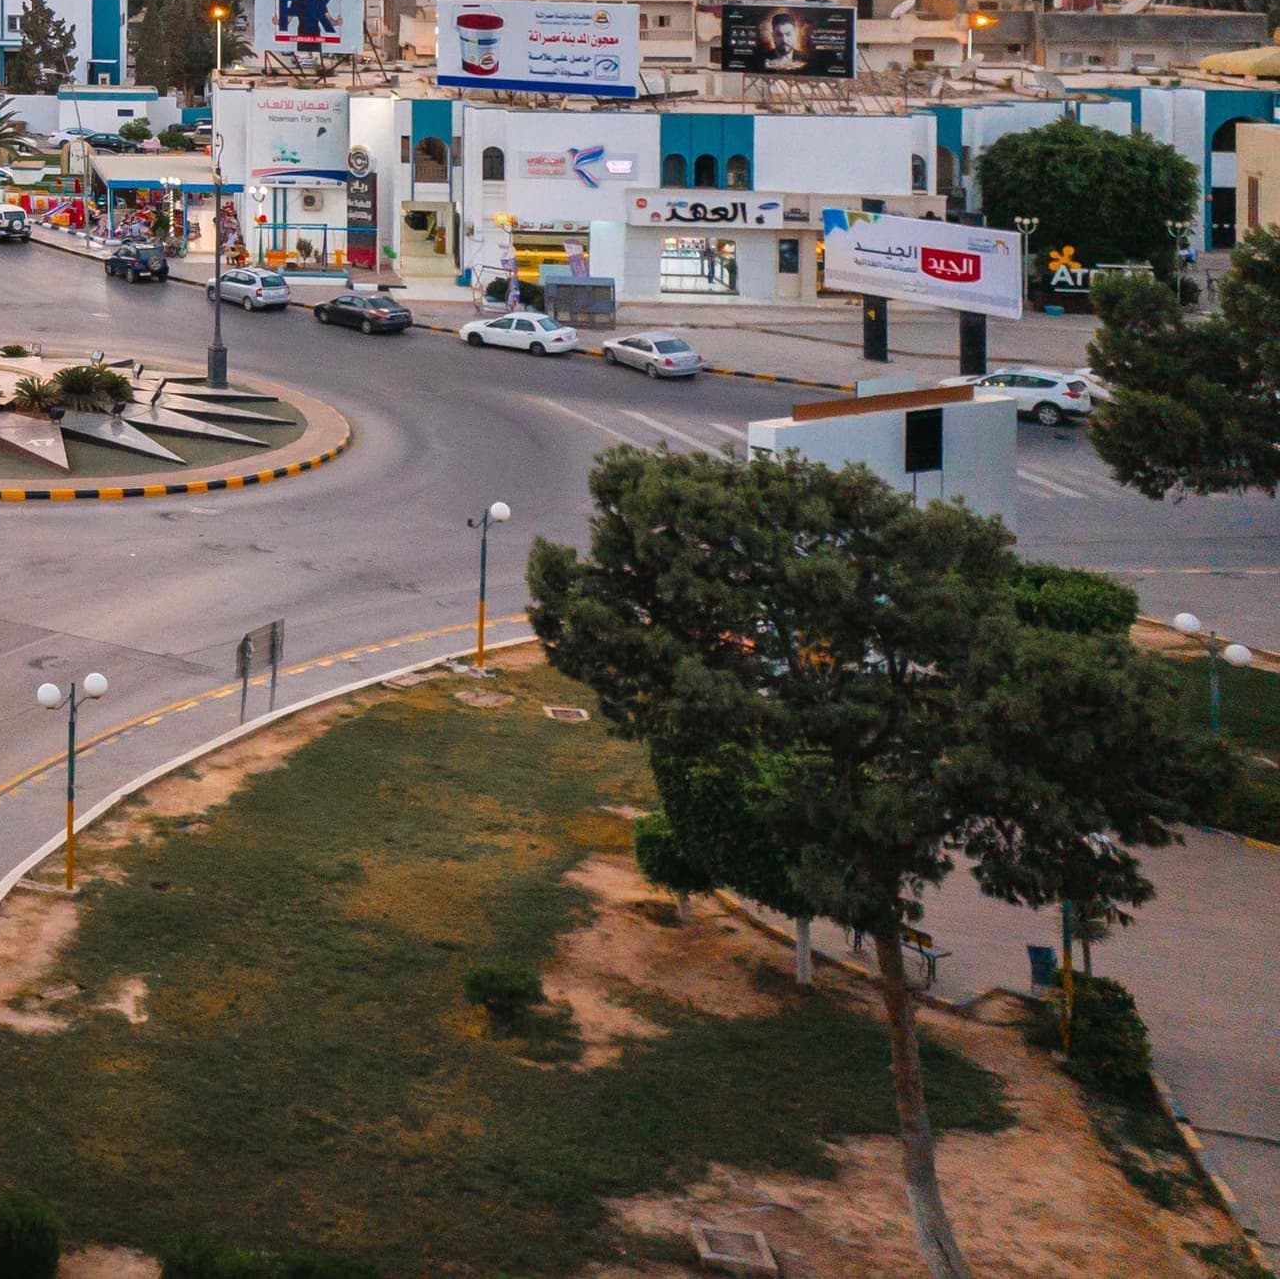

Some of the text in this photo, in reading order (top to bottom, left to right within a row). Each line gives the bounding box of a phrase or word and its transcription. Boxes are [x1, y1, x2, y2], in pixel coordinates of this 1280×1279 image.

[527, 30, 561, 45] مصراتة
[561, 31, 590, 47] المدينة
[854, 242, 918, 261] الجيد
[927, 257, 974, 276] الجيد
